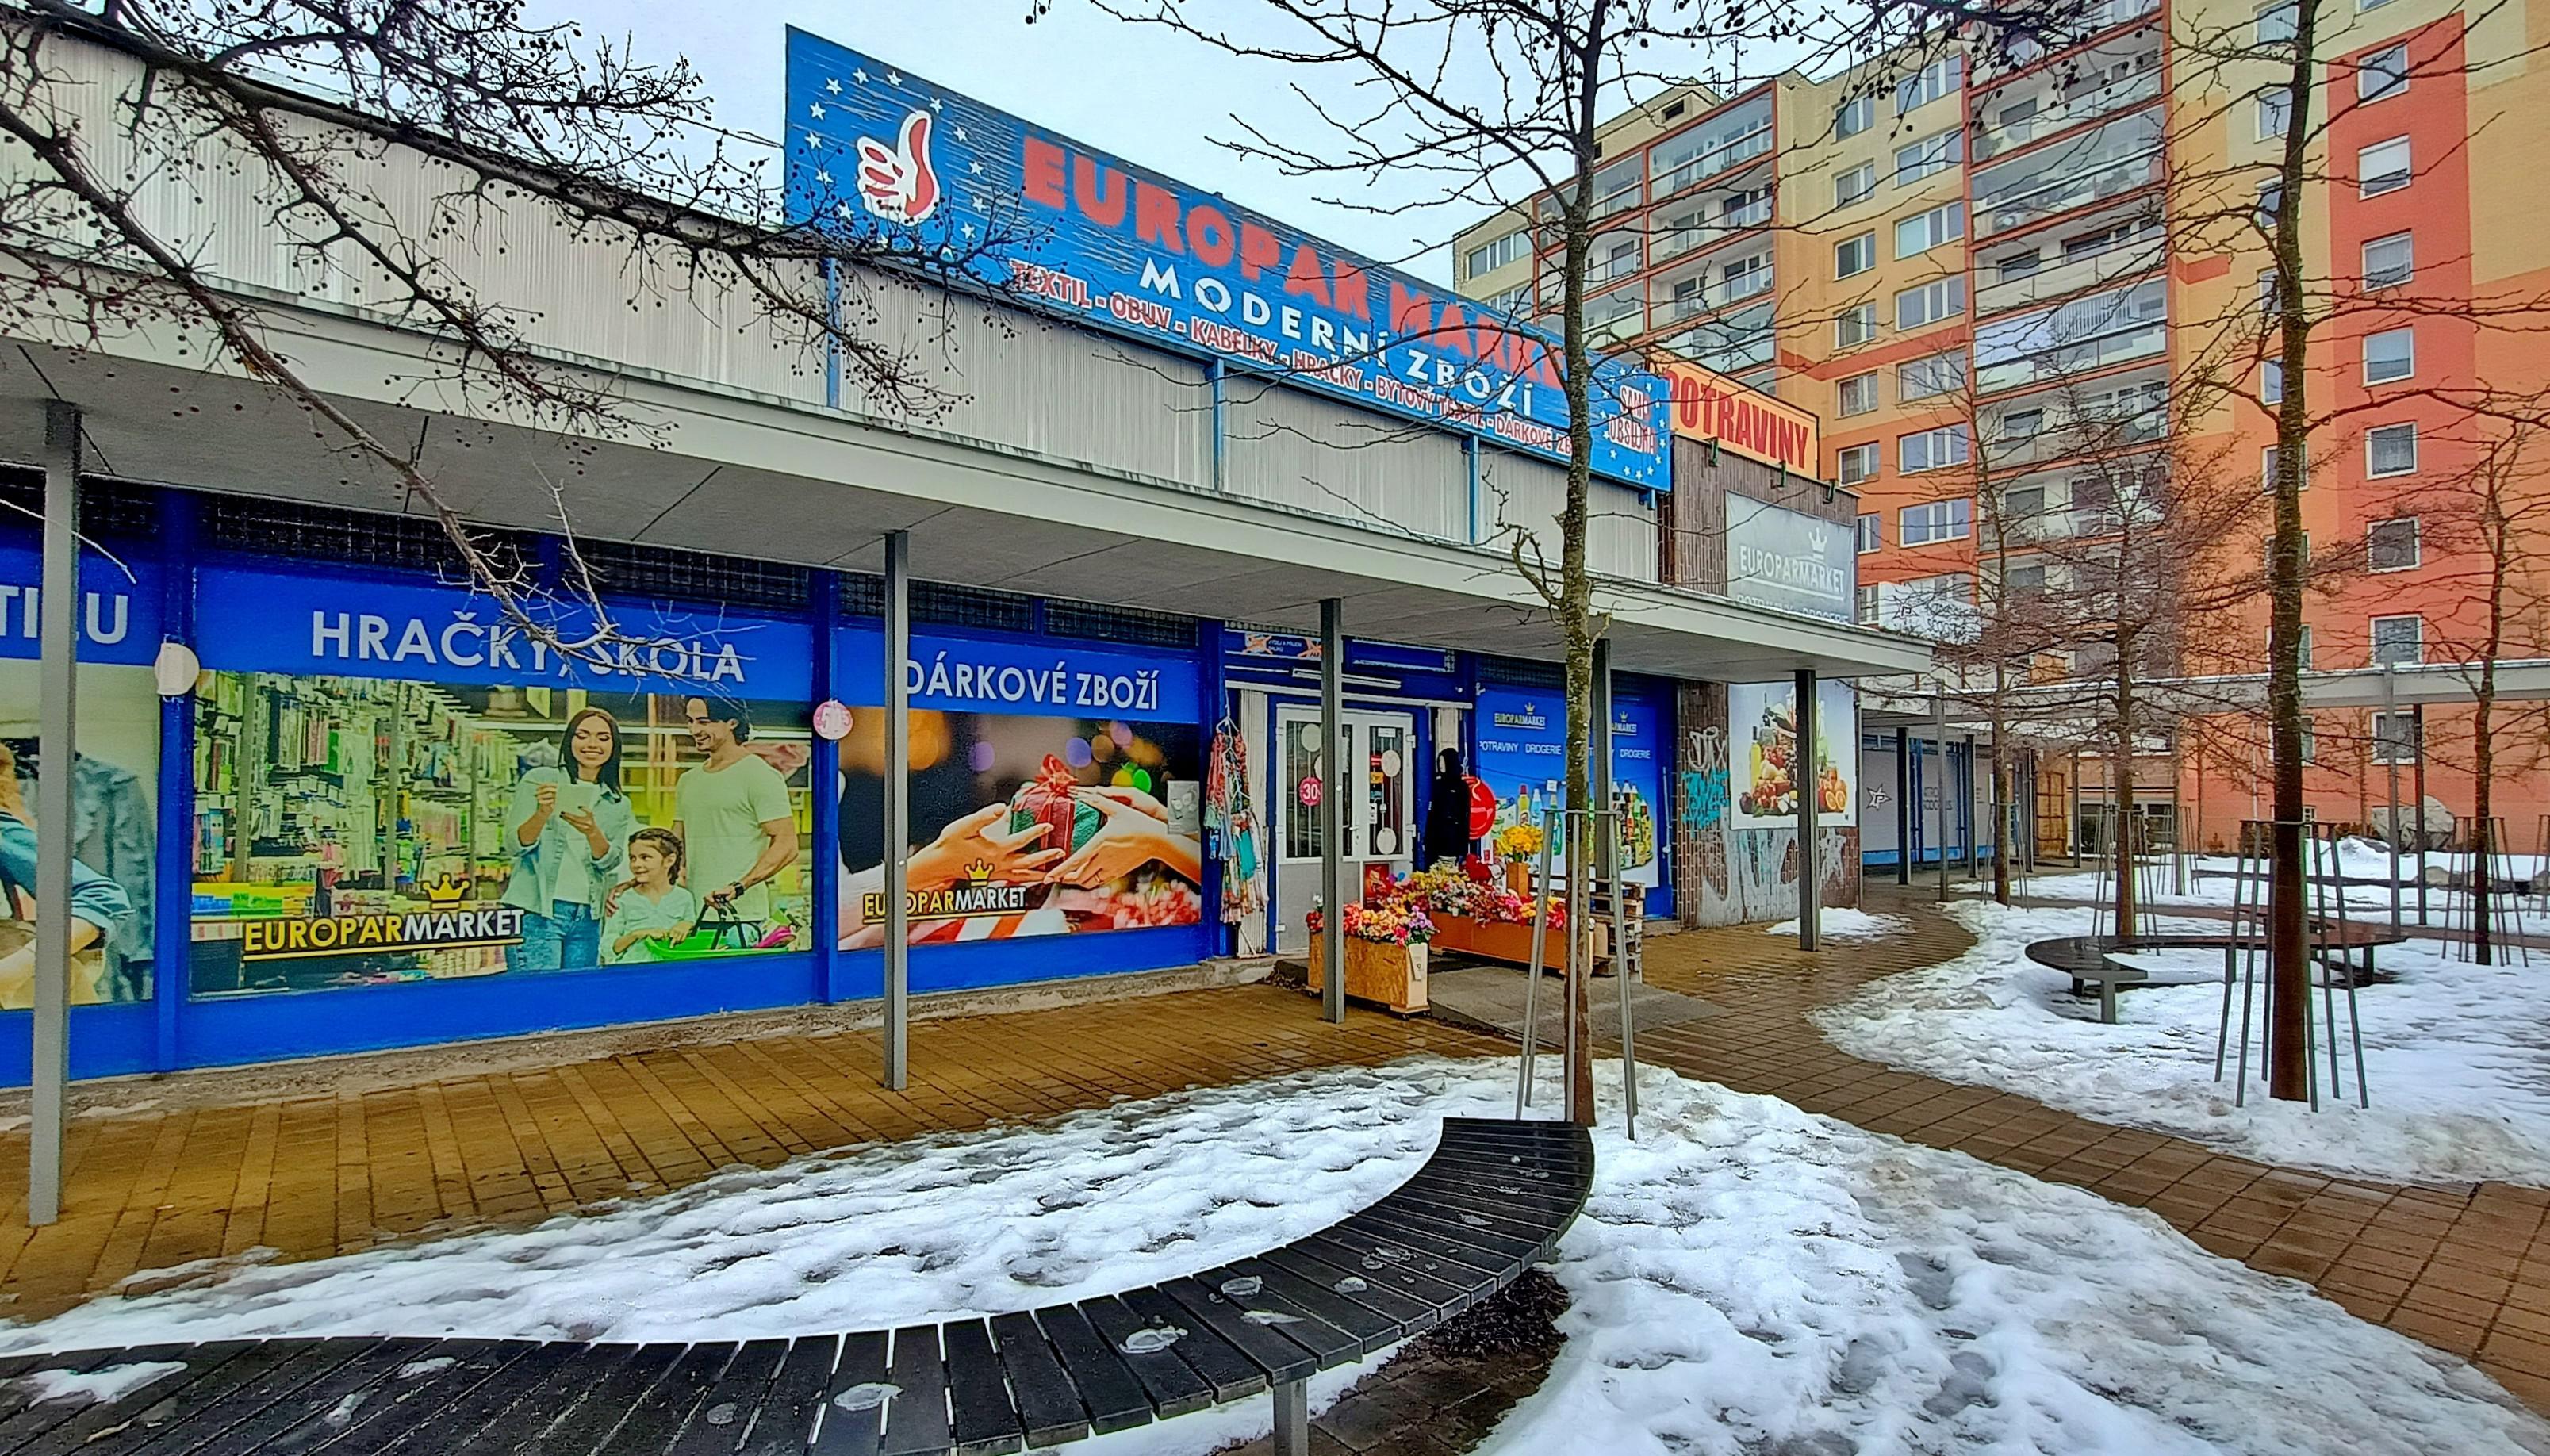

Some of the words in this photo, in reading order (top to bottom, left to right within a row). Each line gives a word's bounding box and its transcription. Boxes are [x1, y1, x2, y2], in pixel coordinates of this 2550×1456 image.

[1009, 259, 1092, 308] TEXTIL
[1110, 292, 1172, 328] OBUV
[1191, 316, 1278, 366] KABELKY
[1293, 348, 1363, 393] HRAČKY
[1375, 374, 1435, 416] BYTOVÝ
[1495, 412, 1553, 451] DÁRKOVÉ
[1139, 256, 1388, 368] MODERNÍ
[1406, 349, 1533, 417] ZBOŽÍ
[1390, 281, 1568, 390] MARKE
[1620, 385, 1651, 420] SAMO
[1665, 370, 1808, 469] POTRAVINY
[1739, 545, 1845, 593] EUROPARMARKET
[589, 623, 746, 682] ŠKOLA
[907, 651, 1066, 704] DÁRKOVÉ
[1076, 669, 1160, 710] ZBOŽÍ
[1525, 743, 1562, 755] DROGERIE
[244, 909, 524, 952] EUROPARMARKET
[863, 887, 1026, 917] EUOPARMARKET
